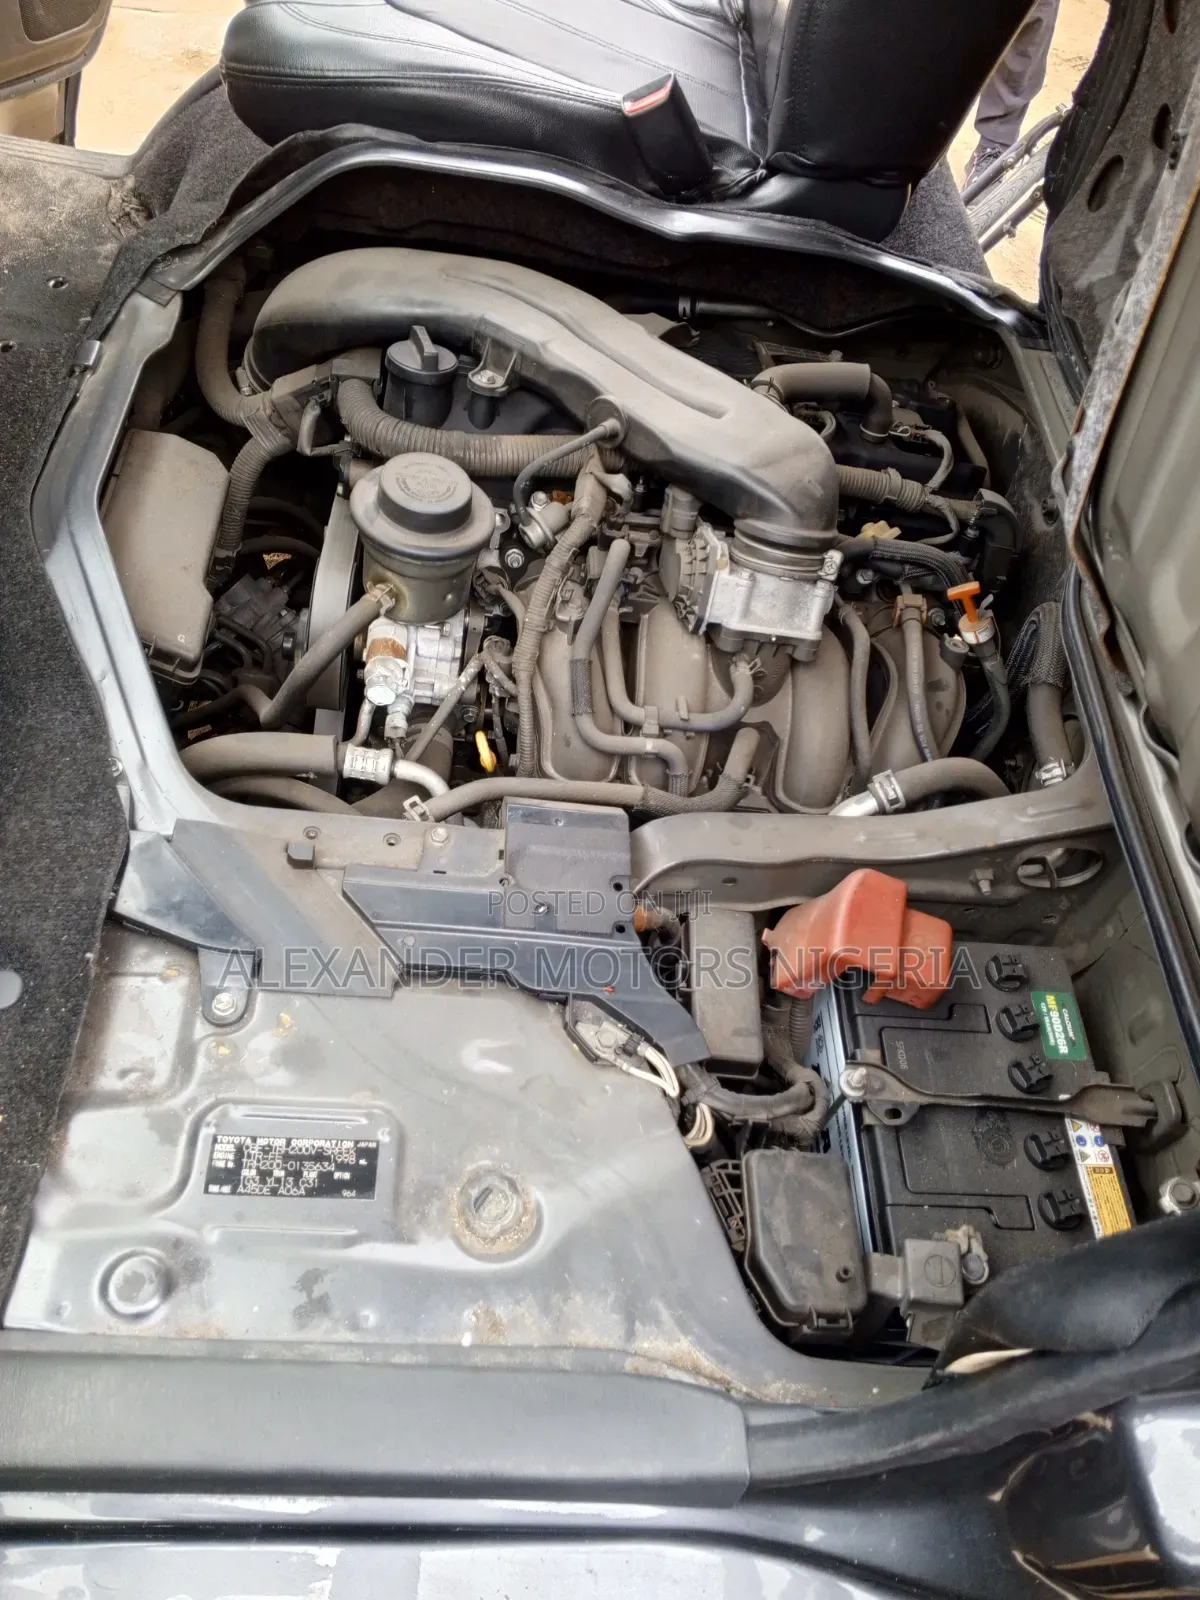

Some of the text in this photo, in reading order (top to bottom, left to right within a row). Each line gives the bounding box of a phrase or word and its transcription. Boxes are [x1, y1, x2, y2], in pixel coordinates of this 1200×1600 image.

[1045, 995, 1069, 1054] MF90D26R
[216, 1135, 377, 1149] TOYOTA MOTOR CORPORATION JAPAN
[330, 1154, 357, 1165] 1998
[341, 1189, 357, 1198] 964
